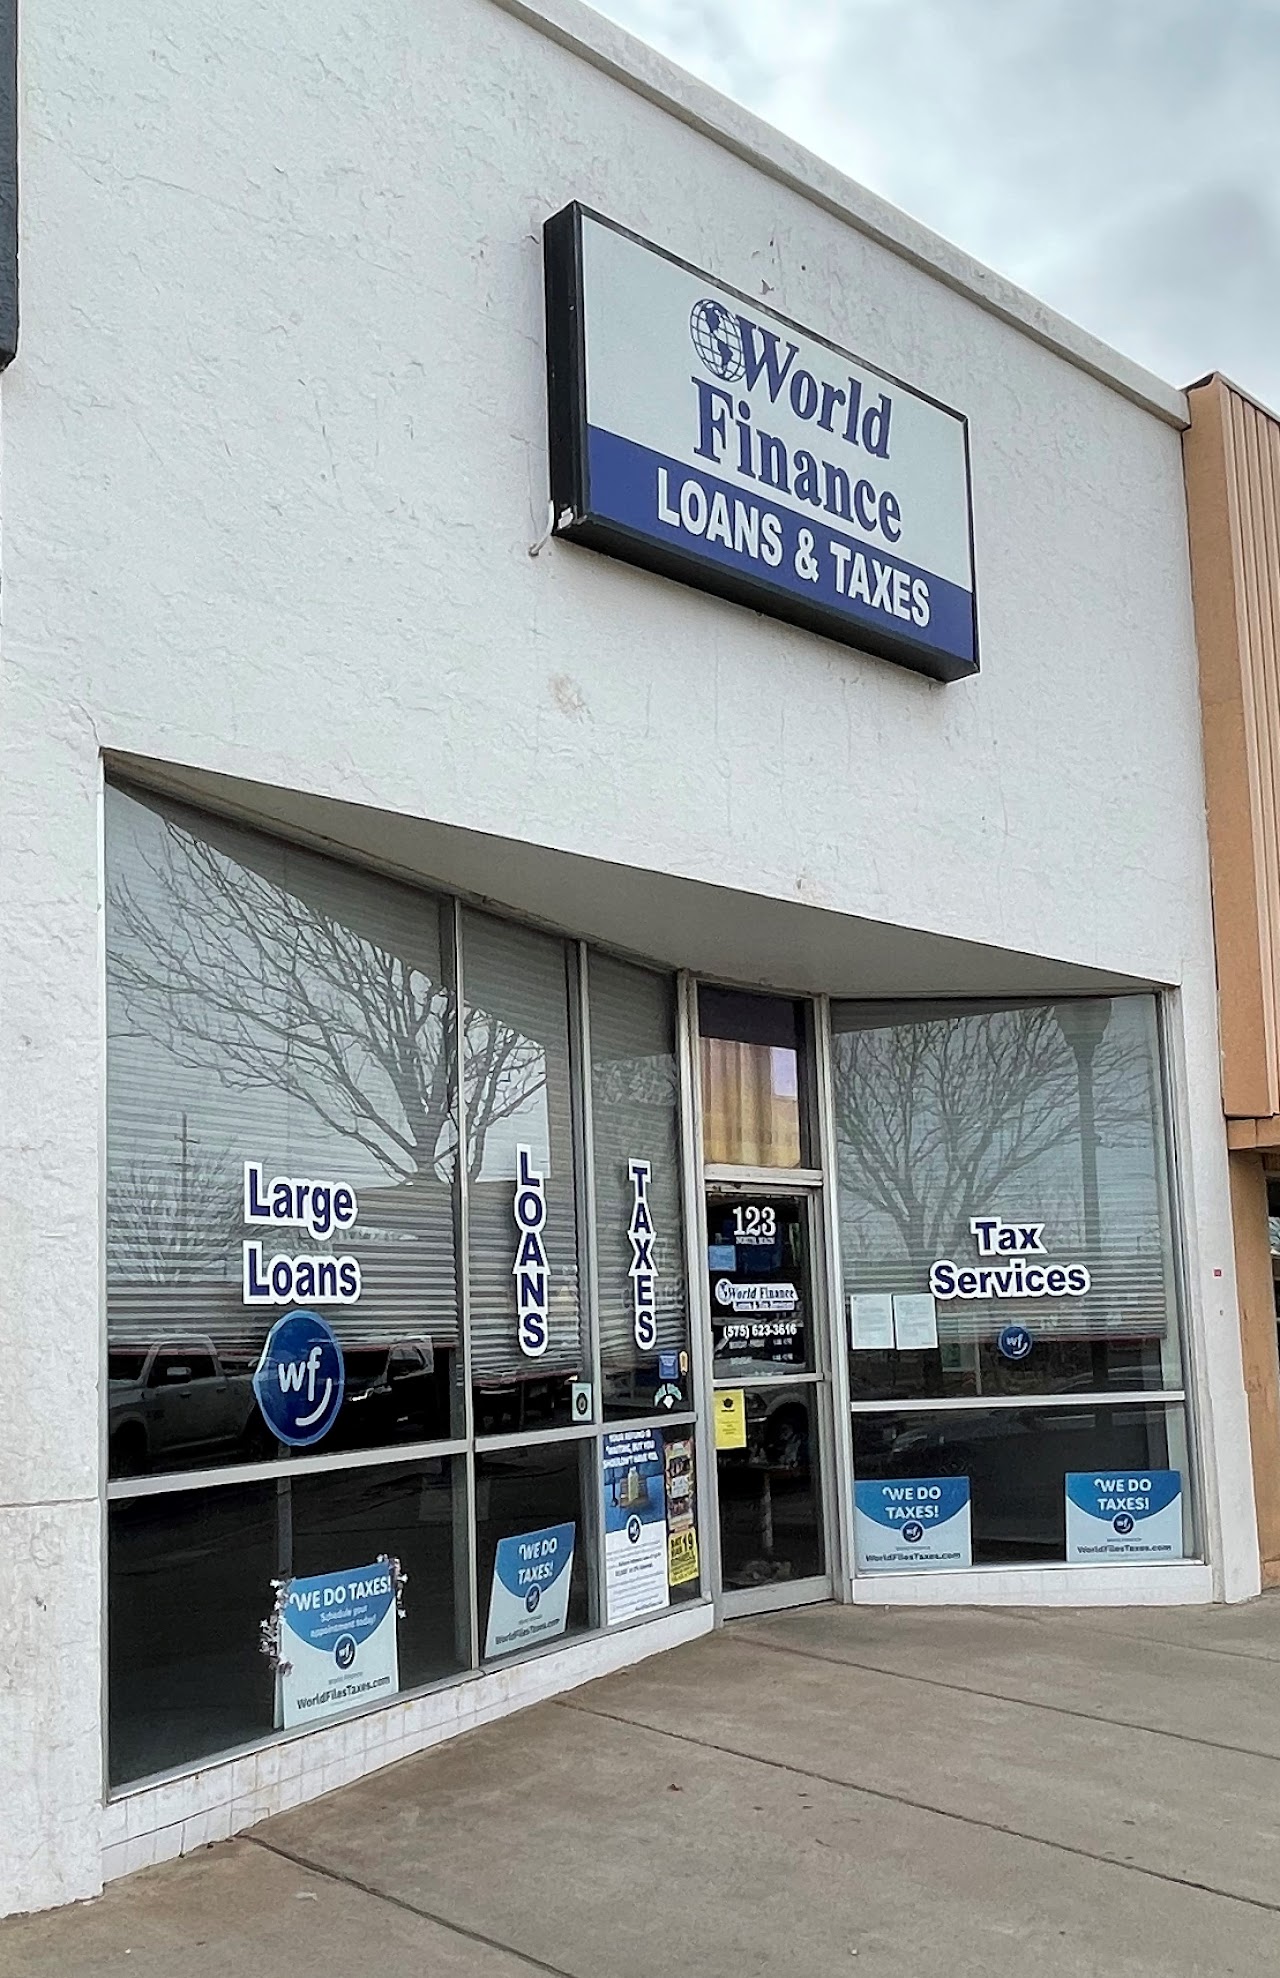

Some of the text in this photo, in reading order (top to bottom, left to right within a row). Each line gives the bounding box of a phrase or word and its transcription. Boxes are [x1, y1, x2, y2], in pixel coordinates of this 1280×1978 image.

[735, 314, 893, 460] World
[691, 376, 902, 543] Finance
[657, 467, 931, 628] LOANS & TAXES
[247, 1166, 355, 1236] Large
[732, 1206, 776, 1236] 123
[974, 1221, 1040, 1251] Tax
[516, 1149, 547, 1350] LOANS
[631, 1164, 655, 1345] TAXES
[247, 1246, 358, 1299] Loans
[933, 1263, 1087, 1295] Services
[728, 1286, 794, 1299] World Finance
[723, 1324, 750, 1339] (575)
[278, 1346, 322, 1401] wf
[882, 1486, 942, 1500] WE DO
[1094, 1478, 1152, 1492] WE DO
[885, 1505, 939, 1520] TAXES!
[1097, 1497, 1149, 1511] TAXES!
[518, 1537, 558, 1561] WE DO
[518, 1560, 554, 1585] TAXES!
[289, 1575, 391, 1612] WE DO TAXES!
[297, 1676, 391, 1710] WorldFilesTaxes.com
